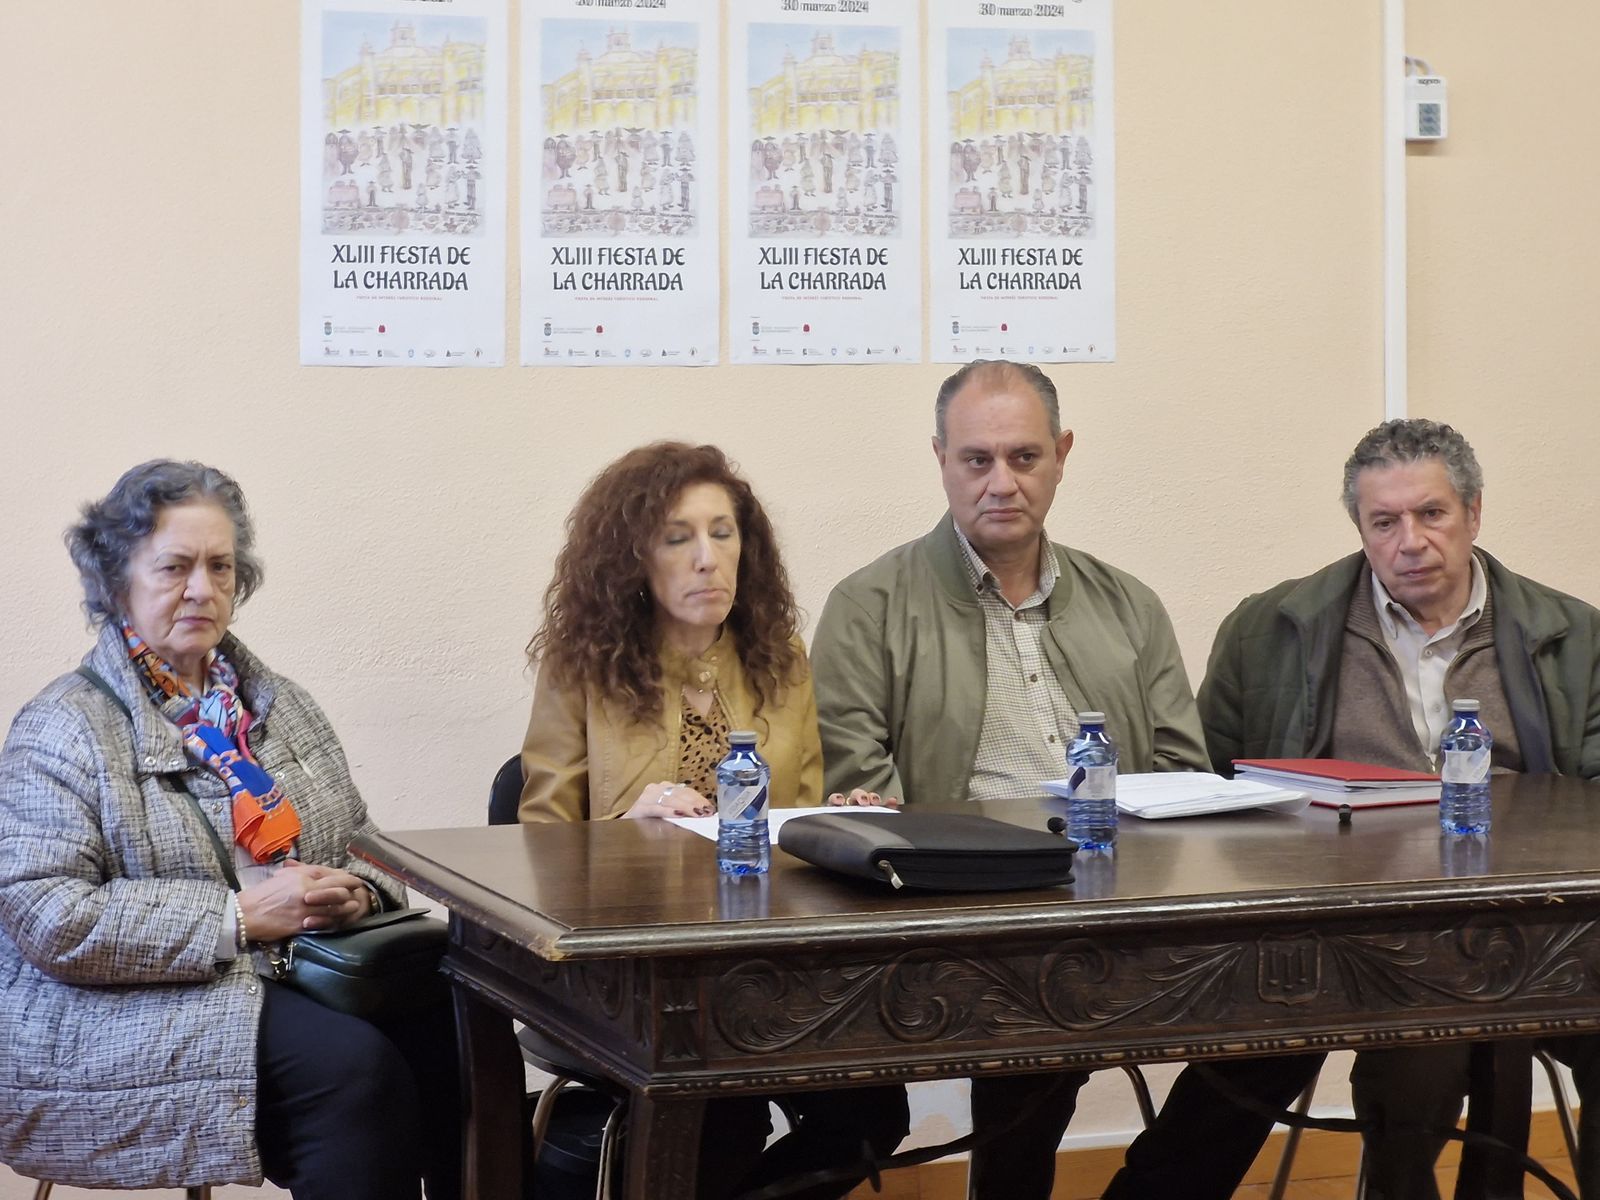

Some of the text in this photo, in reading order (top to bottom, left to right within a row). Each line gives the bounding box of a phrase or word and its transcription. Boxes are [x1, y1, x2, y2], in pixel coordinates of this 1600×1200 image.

[782, 0, 869, 13] 30 marzo 2024
[979, 3, 1064, 18] 30 marzo 2024
[331, 244, 471, 266] XLIII FIESTA DE
[550, 246, 685, 266] XLIII FIESTA DE
[758, 246, 889, 266] XLIII FIESTA DE
[957, 247, 1083, 266] XLIII FIESTA DE
[333, 269, 469, 291] LA CHARRADA
[553, 271, 684, 291] LA CHARRADA
[760, 271, 887, 291] LA CHARRADA
[959, 271, 1082, 291] LA CHARRADA
